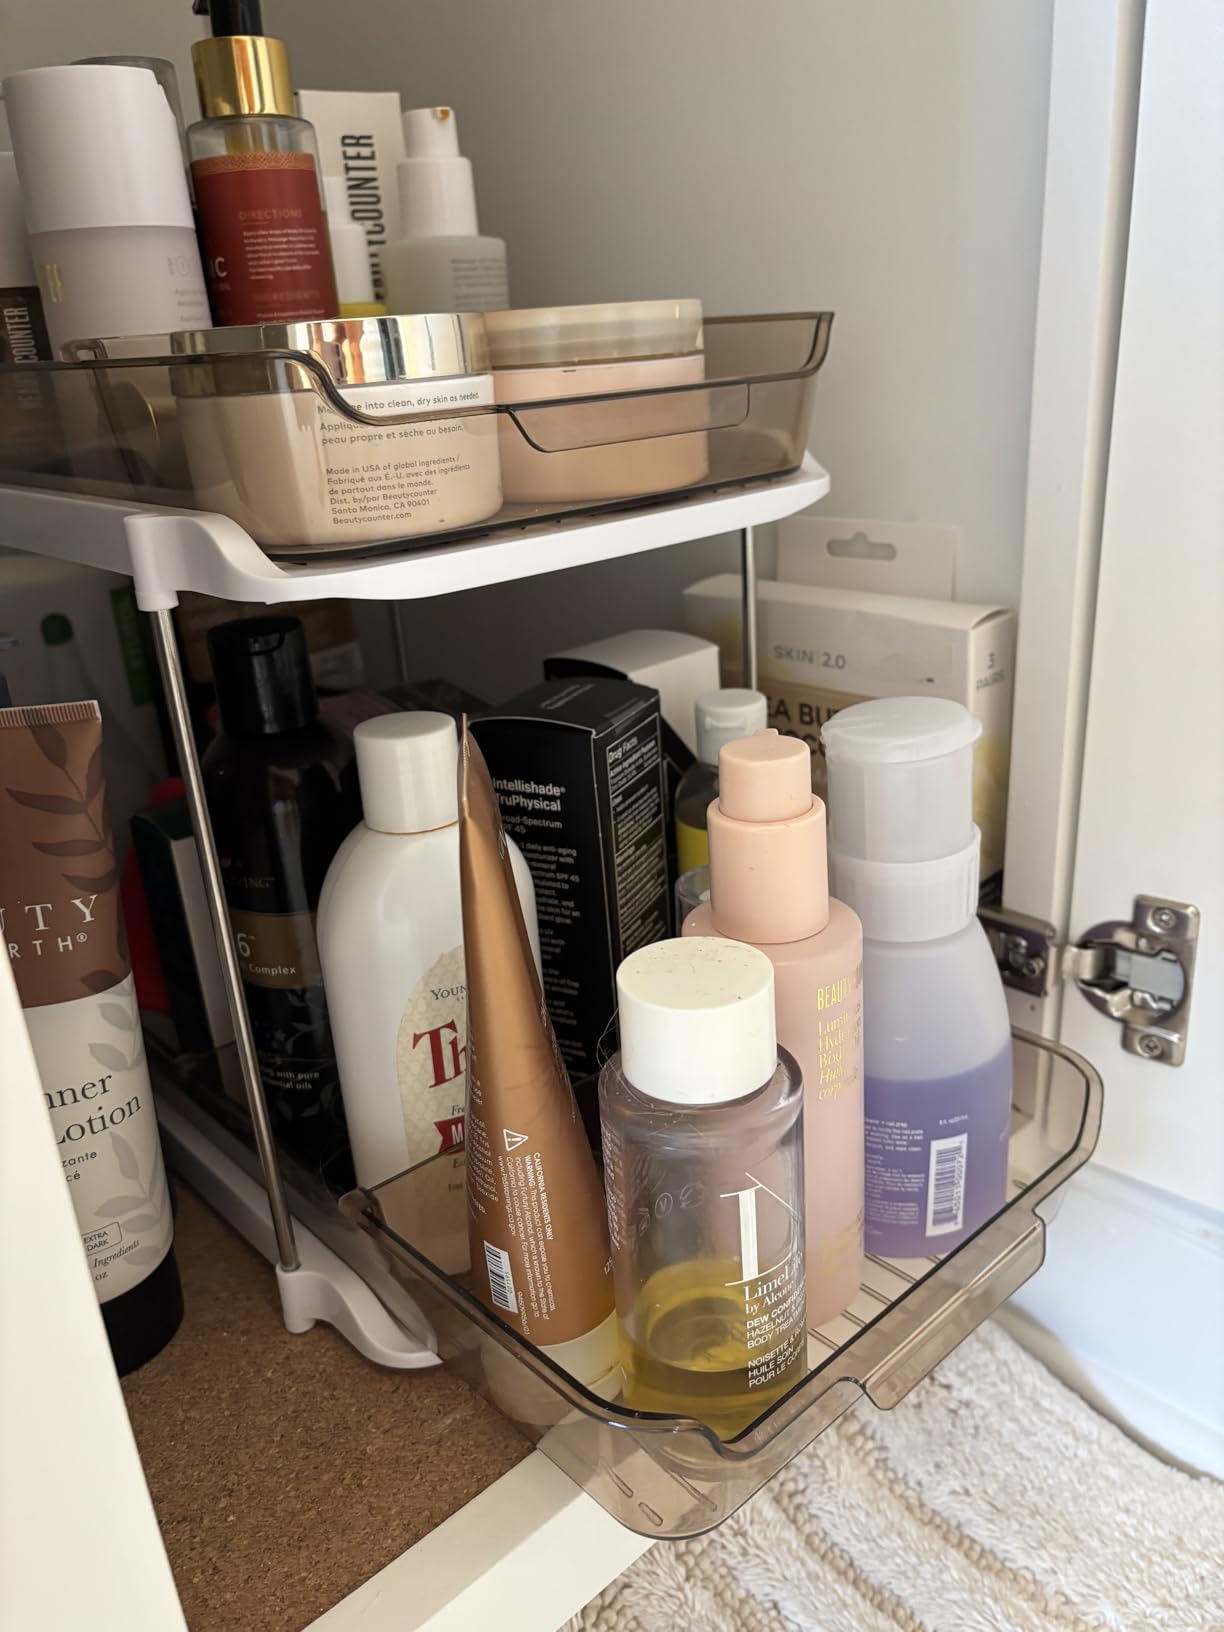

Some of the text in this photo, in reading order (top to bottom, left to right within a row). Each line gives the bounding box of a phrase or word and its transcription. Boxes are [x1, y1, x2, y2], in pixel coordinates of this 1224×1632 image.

[365, 401, 385, 411] into
[387, 399, 415, 409] clean,
[417, 397, 430, 406] dry
[433, 395, 448, 404] skin
[321, 424, 464, 446] peau propre et sèche au besoin.
[326, 467, 350, 476] Made
[352, 466, 360, 474] in
[362, 464, 380, 472] USA
[394, 460, 418, 472] global
[418, 456, 456, 468] ingredients
[327, 476, 366, 487] Fabriqué
[384, 472, 404, 480] É.-U.
[424, 468, 438, 476] des
[438, 464, 471, 476] ingrédients
[328, 487, 340, 496] de
[341, 486, 375, 496] partout
[376, 483, 397, 492] dans
[406, 479, 434, 488] monde.
[330, 488, 438, 506] Dist. by/par Beautycounter
[331, 499, 430, 516] Santa Monica, CA 90401
[332, 512, 412, 526] Beautycounter.com
[773, 644, 846, 670] SKIN 2.0
[505, 1156, 517, 1188] California
[514, 1156, 527, 1186] including
[524, 1154, 536, 1189] WARNING:
[511, 1188, 519, 1196] to
[519, 1186, 530, 1210] Furfuryl
[533, 1152, 553, 1240] CALIFORNIA RESIDENTS ONLY
[512, 1196, 522, 1216] cause
[530, 1201, 542, 1226] product
[523, 1210, 534, 1235] Alcohol,
[84, 1231, 109, 1244] EXTRA
[536, 1227, 544, 1240] can
[86, 1238, 110, 1251] DARK
[94, 1240, 140, 1268] Ingredients
[520, 1241, 529, 1250] For
[528, 1236, 538, 1255] which
[536, 1240, 547, 1262] expose
[522, 1251, 530, 1267] more
[540, 1262, 549, 1273] you
[533, 1260, 542, 1280] known
[544, 1273, 551, 1281] to
[525, 1268, 537, 1301] information
[537, 1287, 545, 1297] the
[530, 1301, 537, 1310] go
[539, 1297, 548, 1312] State
[745, 1302, 760, 1316] by
[746, 1314, 770, 1329] DEW
[746, 1312, 790, 1339] HAZELNUT
[747, 1334, 774, 1349] BODY
[748, 1342, 789, 1368] NOISETTE
[748, 1346, 794, 1379] HUILE SOIN
[748, 1371, 775, 1388] POUR
[777, 1364, 786, 1377] LE
